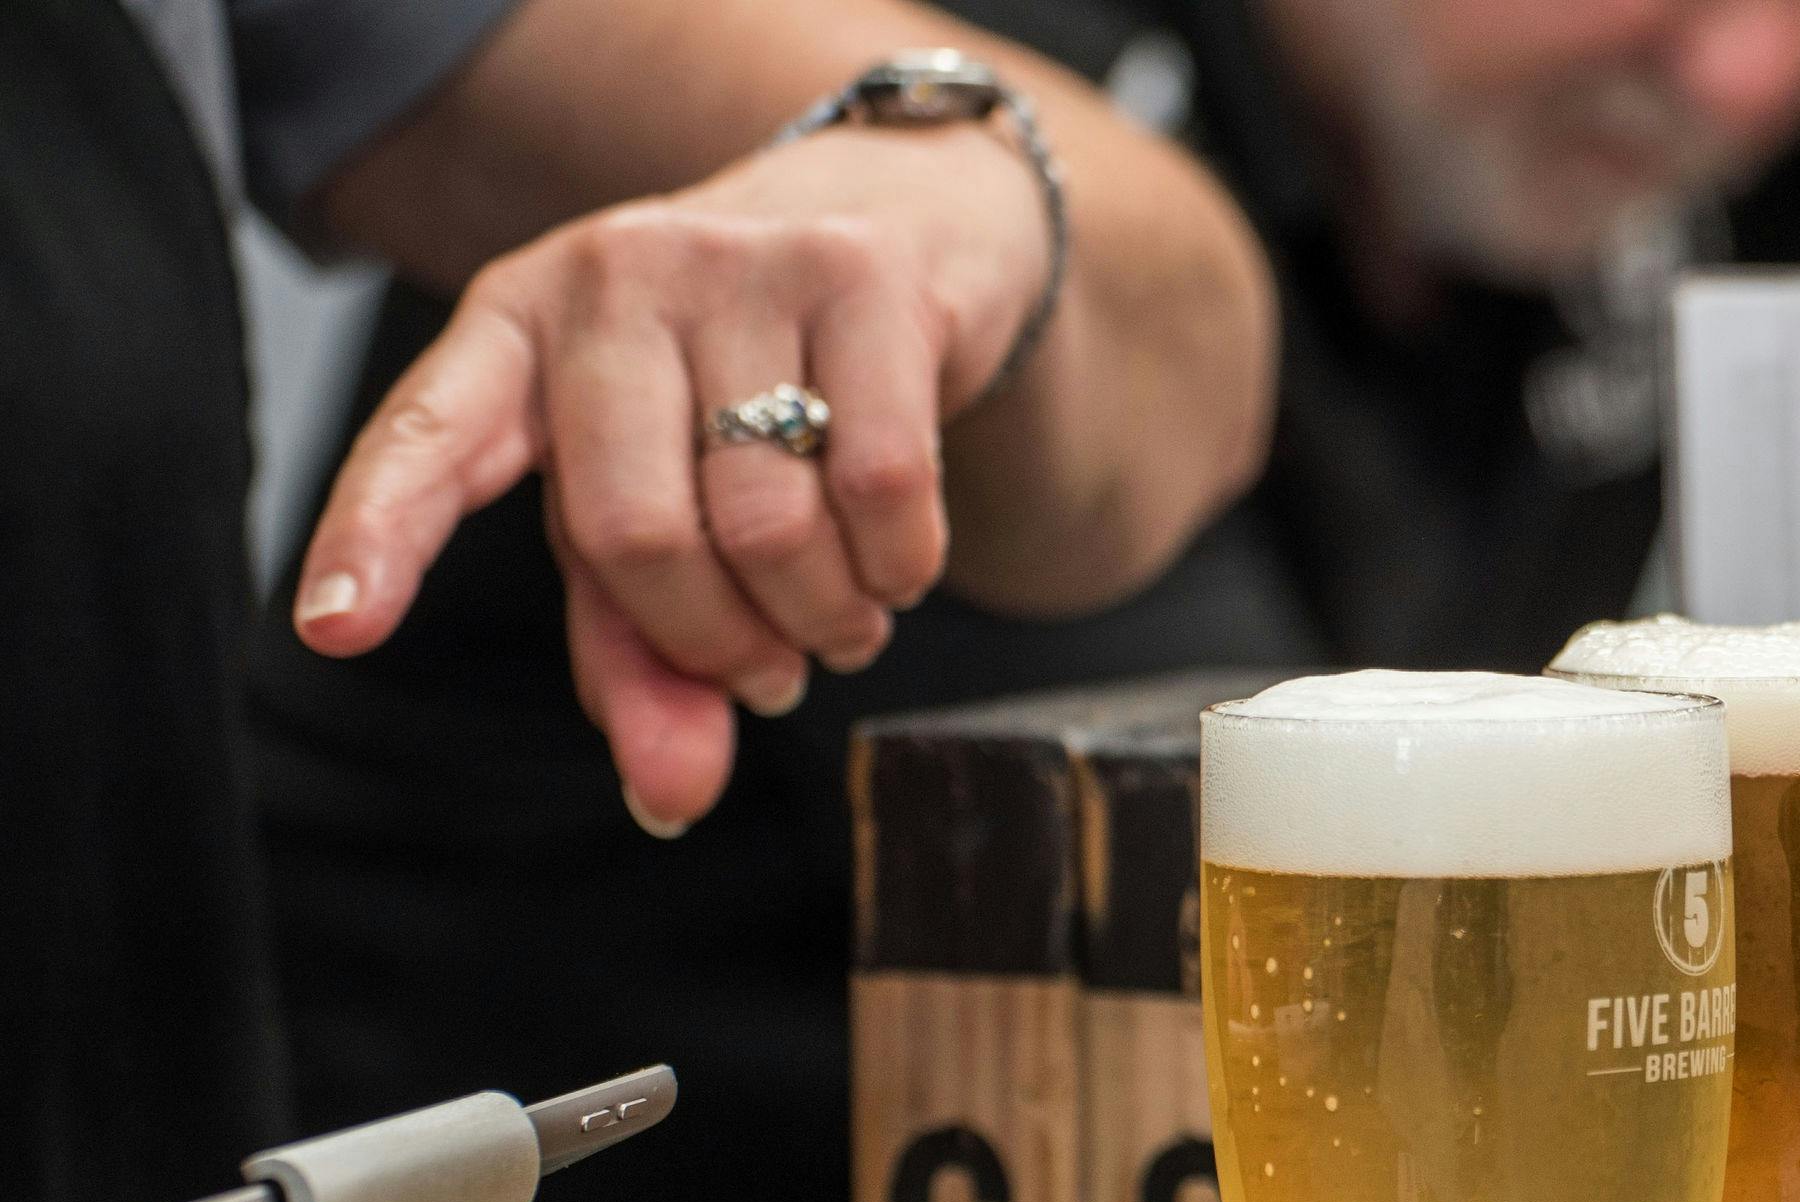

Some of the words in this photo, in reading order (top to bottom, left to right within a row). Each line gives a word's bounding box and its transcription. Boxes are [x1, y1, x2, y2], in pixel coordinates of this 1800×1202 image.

[1683, 871, 1710, 949] 5
[1587, 993, 1670, 1052] FIVE
[1645, 1044, 1727, 1084] BREWING
